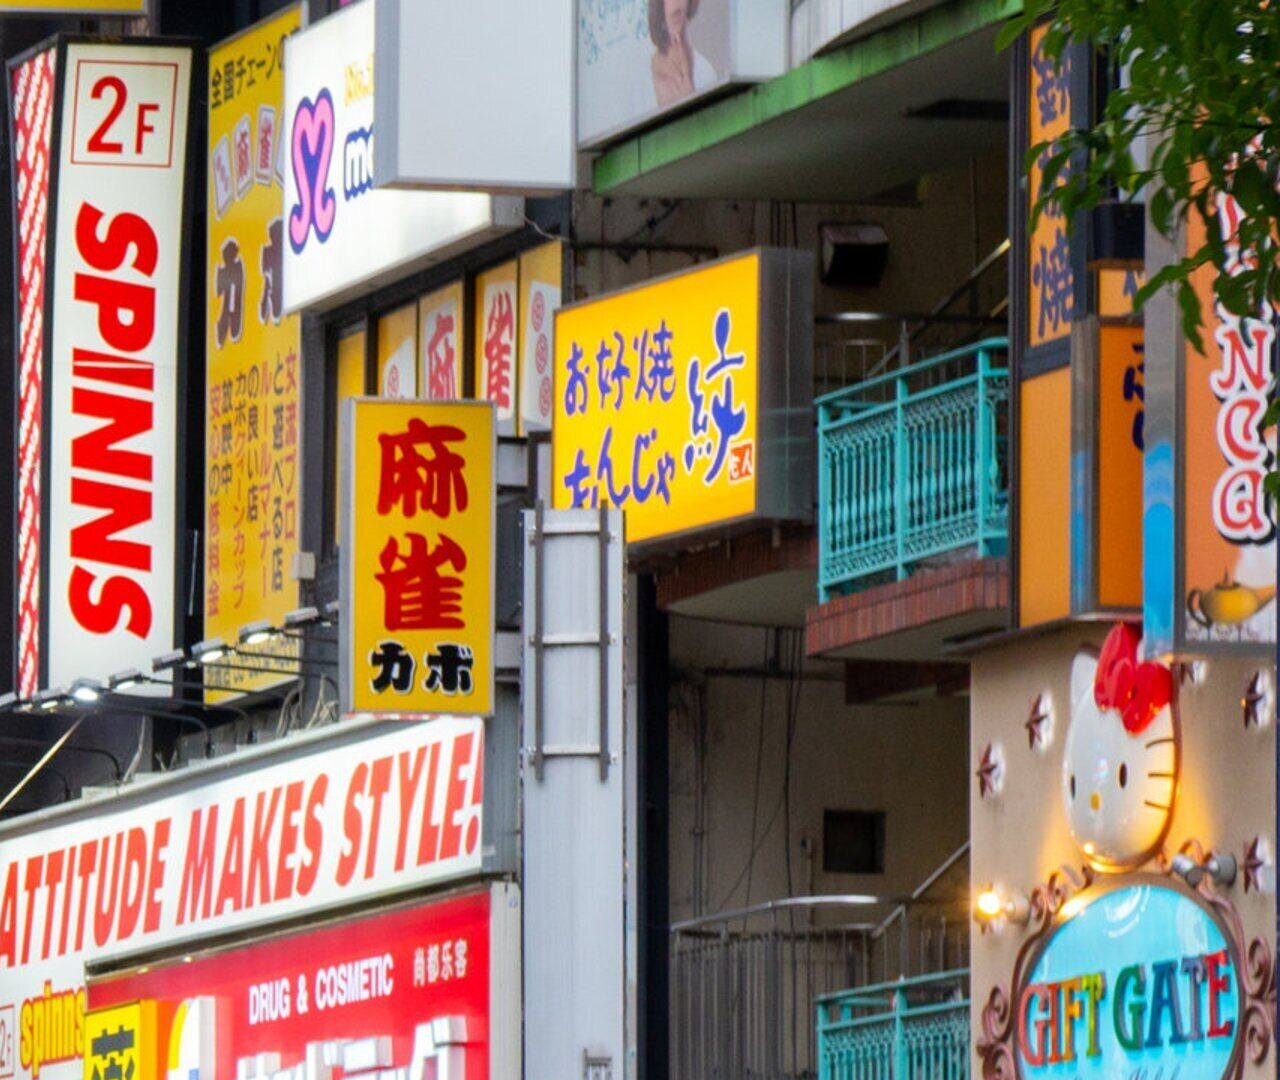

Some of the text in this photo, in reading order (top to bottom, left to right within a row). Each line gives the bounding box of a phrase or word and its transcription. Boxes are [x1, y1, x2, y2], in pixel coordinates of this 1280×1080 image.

[87, 75, 160, 154] 2F
[68, 201, 159, 641] SPINNS
[375, 417, 469, 633] 麻雀
[370, 640, 475, 695] カボ
[177, 773, 328, 925] MAKES
[334, 731, 484, 887] STYLE!
[248, 954, 393, 1025] DRUG & COSMETIC
[1017, 949, 1234, 1068] GIFT GATE
